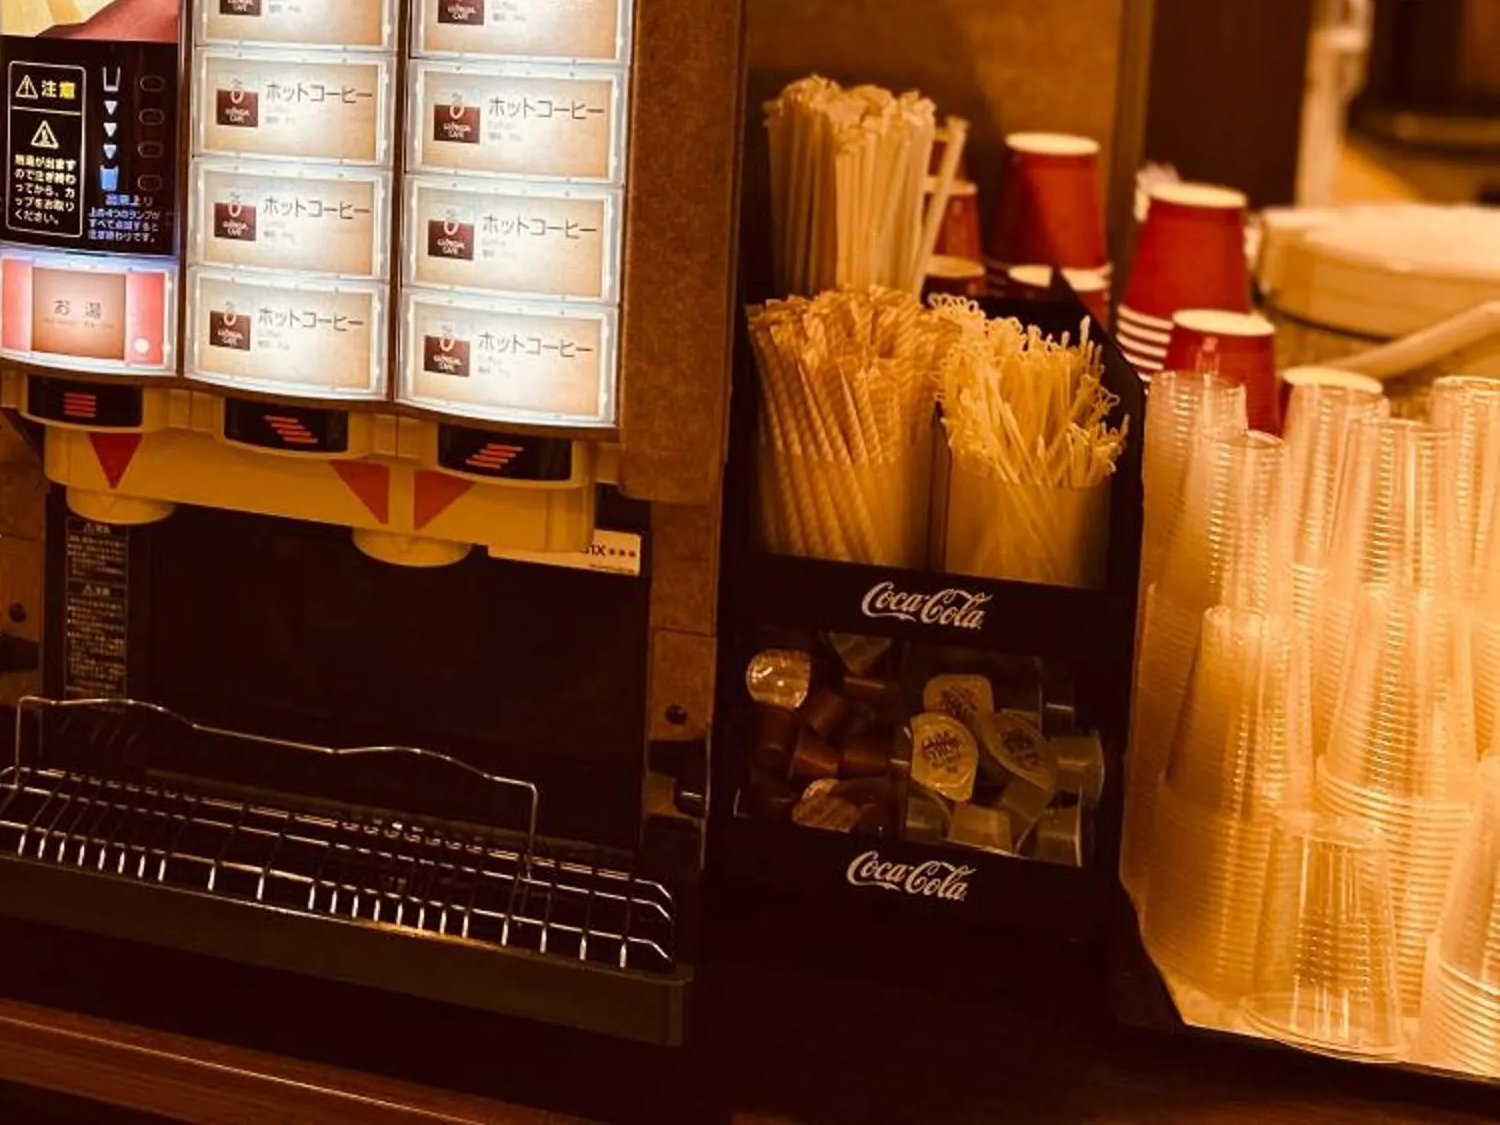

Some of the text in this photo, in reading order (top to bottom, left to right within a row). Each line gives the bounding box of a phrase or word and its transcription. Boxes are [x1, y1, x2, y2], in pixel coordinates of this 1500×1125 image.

[265, 82, 373, 104] ホットコーヒー
[488, 97, 605, 121] ホットコーヒー
[263, 197, 371, 221] ホットコーヒー
[482, 214, 597, 240] ホットコーヒー
[257, 307, 365, 333] ホットコーヒー
[478, 330, 593, 358] ホットコーヒー
[861, 581, 994, 630] Coca-Cola
[847, 850, 977, 902] Coca-Cola
